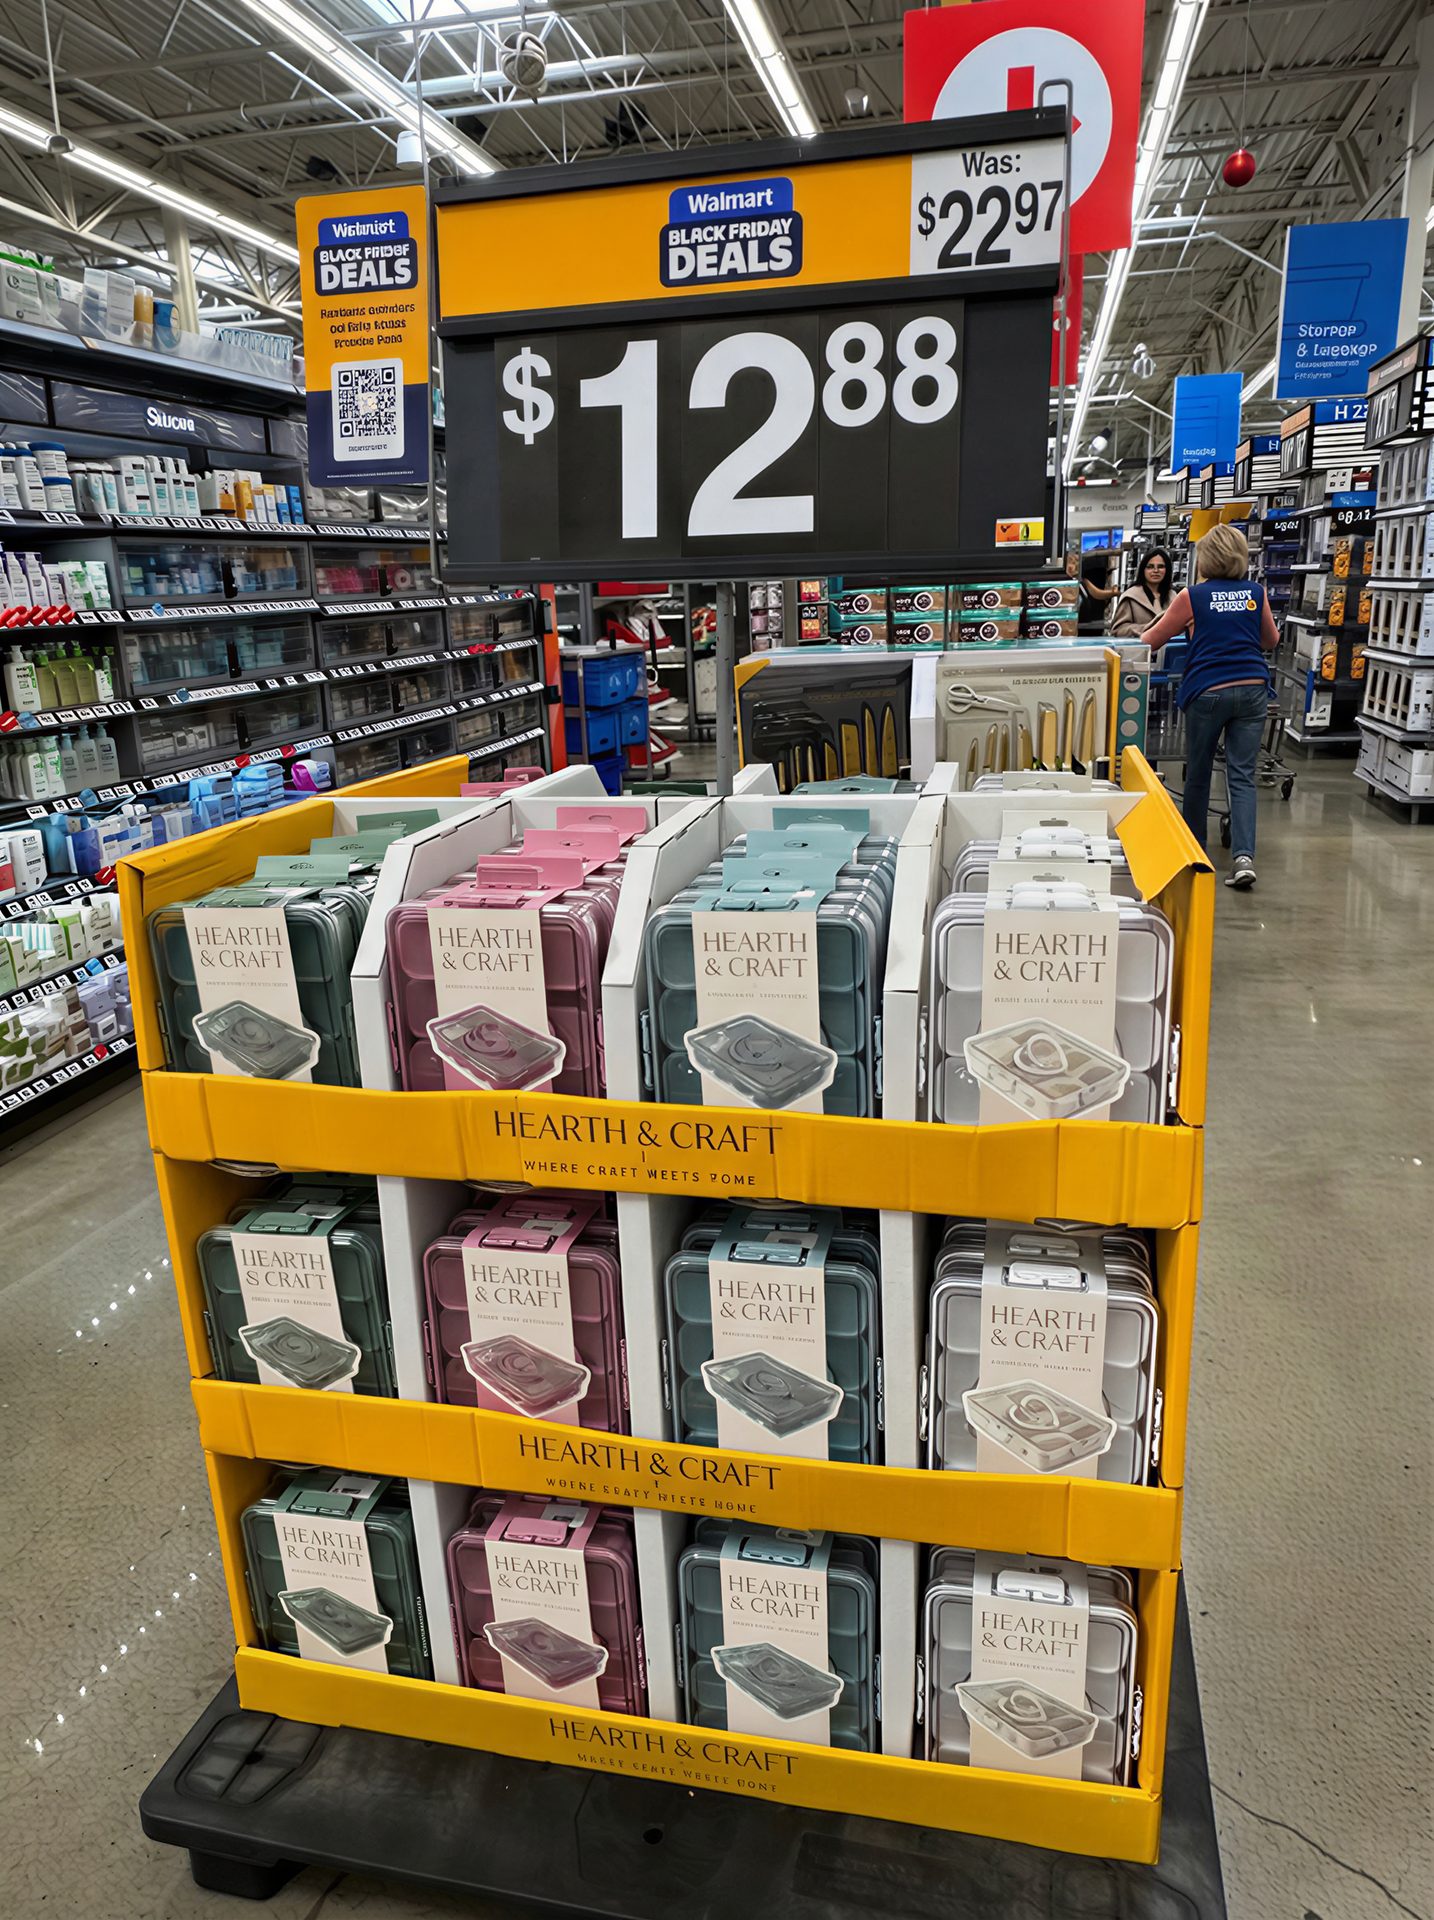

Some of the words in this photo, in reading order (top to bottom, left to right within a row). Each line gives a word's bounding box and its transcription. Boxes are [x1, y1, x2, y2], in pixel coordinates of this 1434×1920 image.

[962, 152, 1022, 177] Was:
[688, 187, 773, 215] Walmart
[668, 223, 726, 247] BLACK
[728, 217, 792, 241] FRIDAY
[668, 235, 793, 280] DEALS
[320, 257, 412, 290] DEALS
[194, 926, 283, 947] HEARTH
[438, 927, 534, 950] HEARTH
[703, 931, 808, 954] HEARTH
[995, 933, 1108, 957] HEARTH
[200, 950, 215, 968] &
[218, 949, 285, 970] CRAFT
[442, 952, 457, 970] &
[460, 951, 535, 973] CRAFT
[704, 958, 722, 977] &
[728, 957, 808, 979] CRAFT
[994, 960, 1013, 980] &
[1019, 960, 1107, 983] CRAFT
[494, 1110, 627, 1144] HEARTH
[637, 1120, 662, 1147] &
[669, 1121, 783, 1154] CRAFT
[524, 1160, 579, 1174] WHERE
[472, 1263, 562, 1289] HEARTH
[475, 1285, 489, 1303] &
[493, 1288, 563, 1309] CRAFT
[718, 1279, 816, 1305] HEARTH
[720, 1302, 737, 1319] &
[741, 1303, 816, 1326] CRAFT
[991, 1305, 1096, 1333] HEARTH
[990, 1329, 1008, 1347] &
[1014, 1330, 1095, 1355] CRAFT
[519, 1434, 640, 1473] HEARTH
[649, 1452, 672, 1477] &
[679, 1456, 782, 1490] CRAFT
[495, 1554, 580, 1580] HEARTH
[497, 1574, 512, 1588] &
[728, 1574, 820, 1602] HEARTH
[730, 1594, 745, 1611] &
[750, 1596, 820, 1621] CRAFT
[981, 1610, 1080, 1640] HEARTH
[981, 1632, 998, 1649] &
[1003, 1633, 1080, 1658] CRAFT
[549, 1718, 665, 1754] HEARTH
[674, 1738, 695, 1760] &
[702, 1742, 800, 1775] CRAFT
